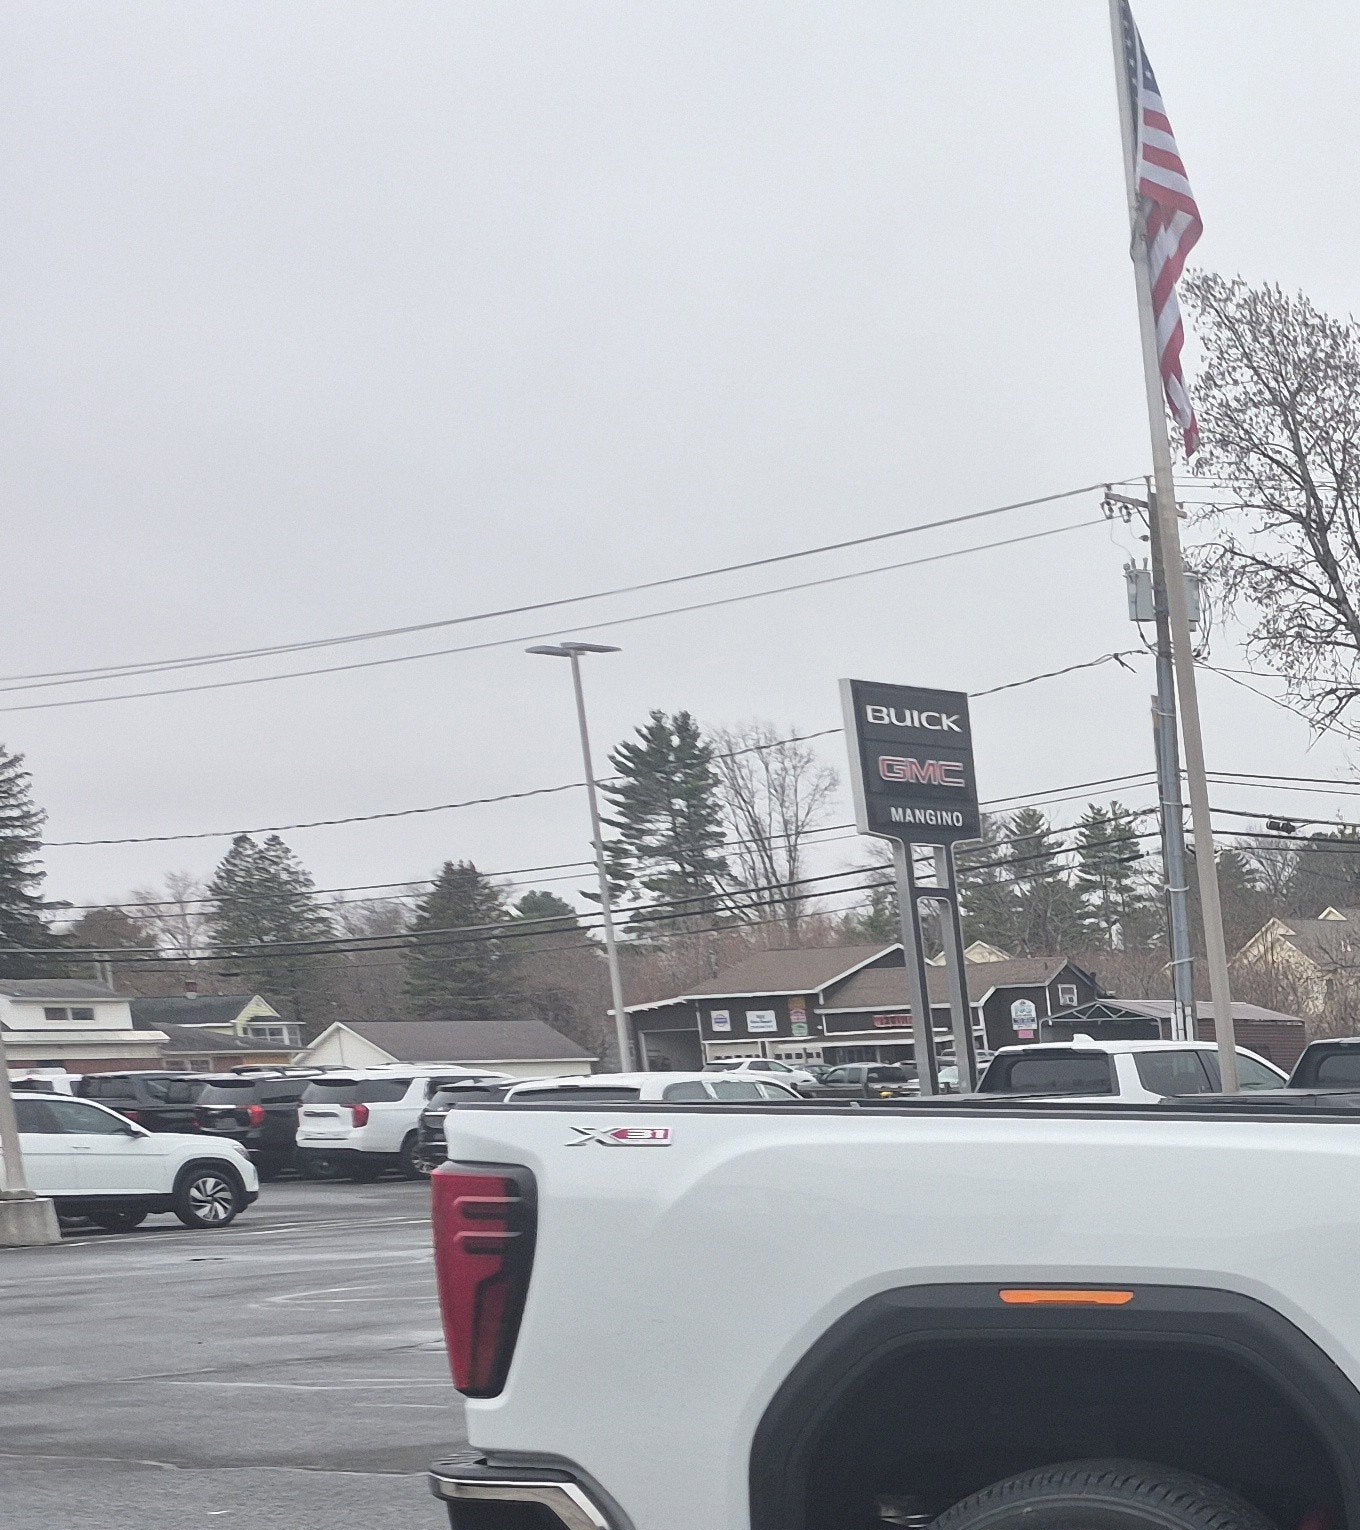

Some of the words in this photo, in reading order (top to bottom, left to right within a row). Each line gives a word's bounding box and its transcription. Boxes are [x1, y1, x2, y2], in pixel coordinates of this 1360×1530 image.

[865, 704, 963, 732] BUICK
[878, 755, 966, 788] GMC
[890, 806, 963, 827] MANGINO
